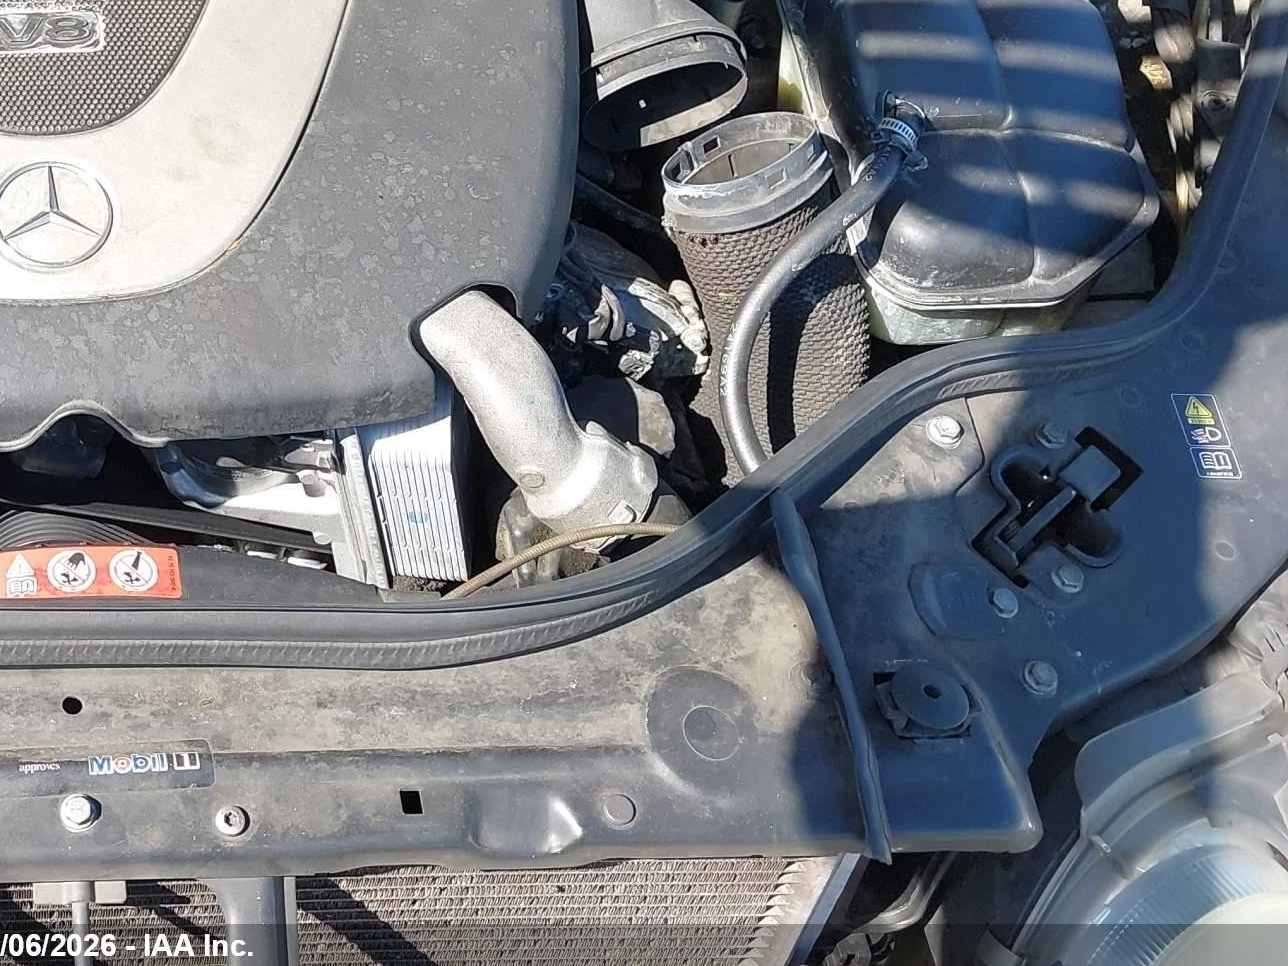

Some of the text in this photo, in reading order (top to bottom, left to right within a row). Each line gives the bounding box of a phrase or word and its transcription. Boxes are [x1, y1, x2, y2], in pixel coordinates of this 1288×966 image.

[18, 752, 201, 776] approves Mobil 1
